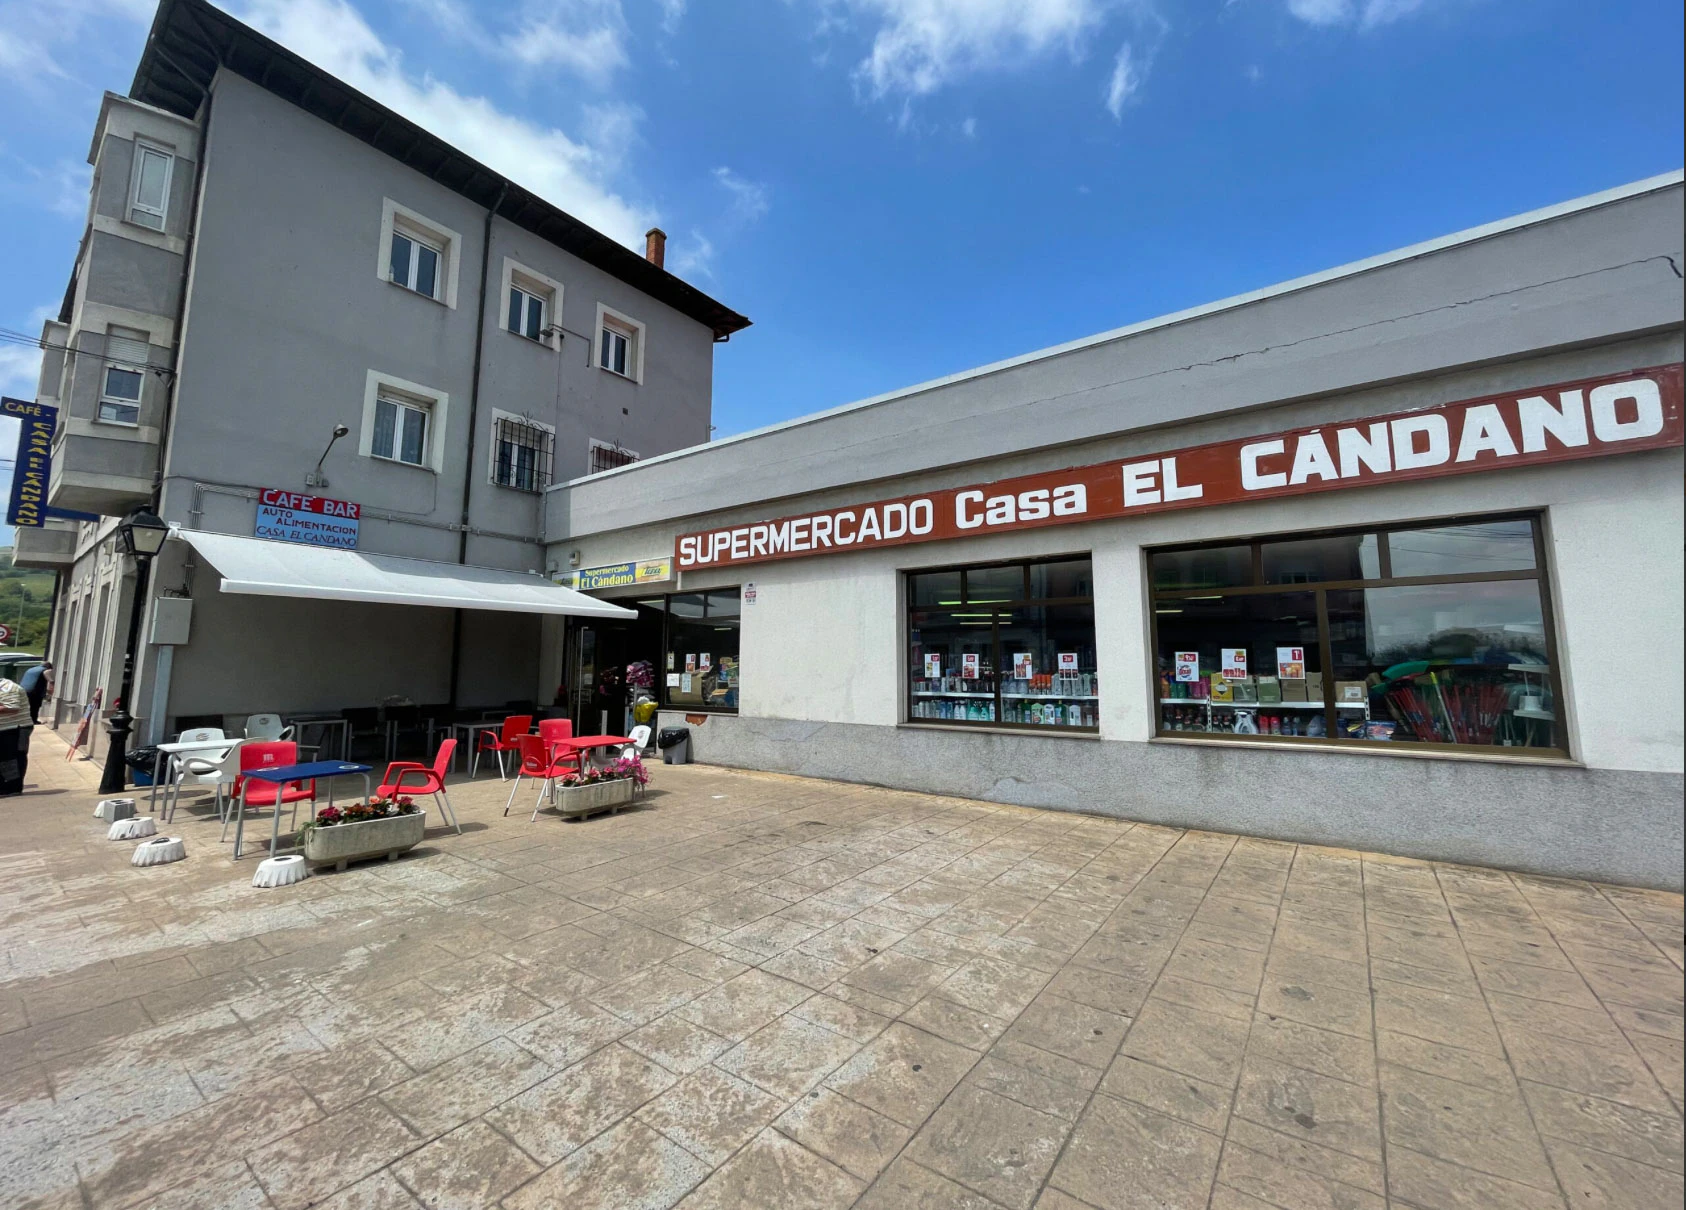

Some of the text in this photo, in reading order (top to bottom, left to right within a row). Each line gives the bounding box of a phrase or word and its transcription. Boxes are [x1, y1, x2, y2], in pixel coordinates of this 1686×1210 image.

[5, 402, 42, 416] CAFÉ
[28, 422, 52, 455] CASA
[262, 507, 293, 518] AUTO
[263, 490, 357, 518] CAFE BAR
[679, 499, 933, 566] SUPERMERCADO
[955, 483, 1087, 529] Casa
[1122, 457, 1203, 507] EL
[276, 518, 356, 535] ALIMENTACION
[256, 525, 357, 547] CASA EL CANDANO
[585, 564, 629, 577] Supermercado
[581, 578, 590, 589] El
